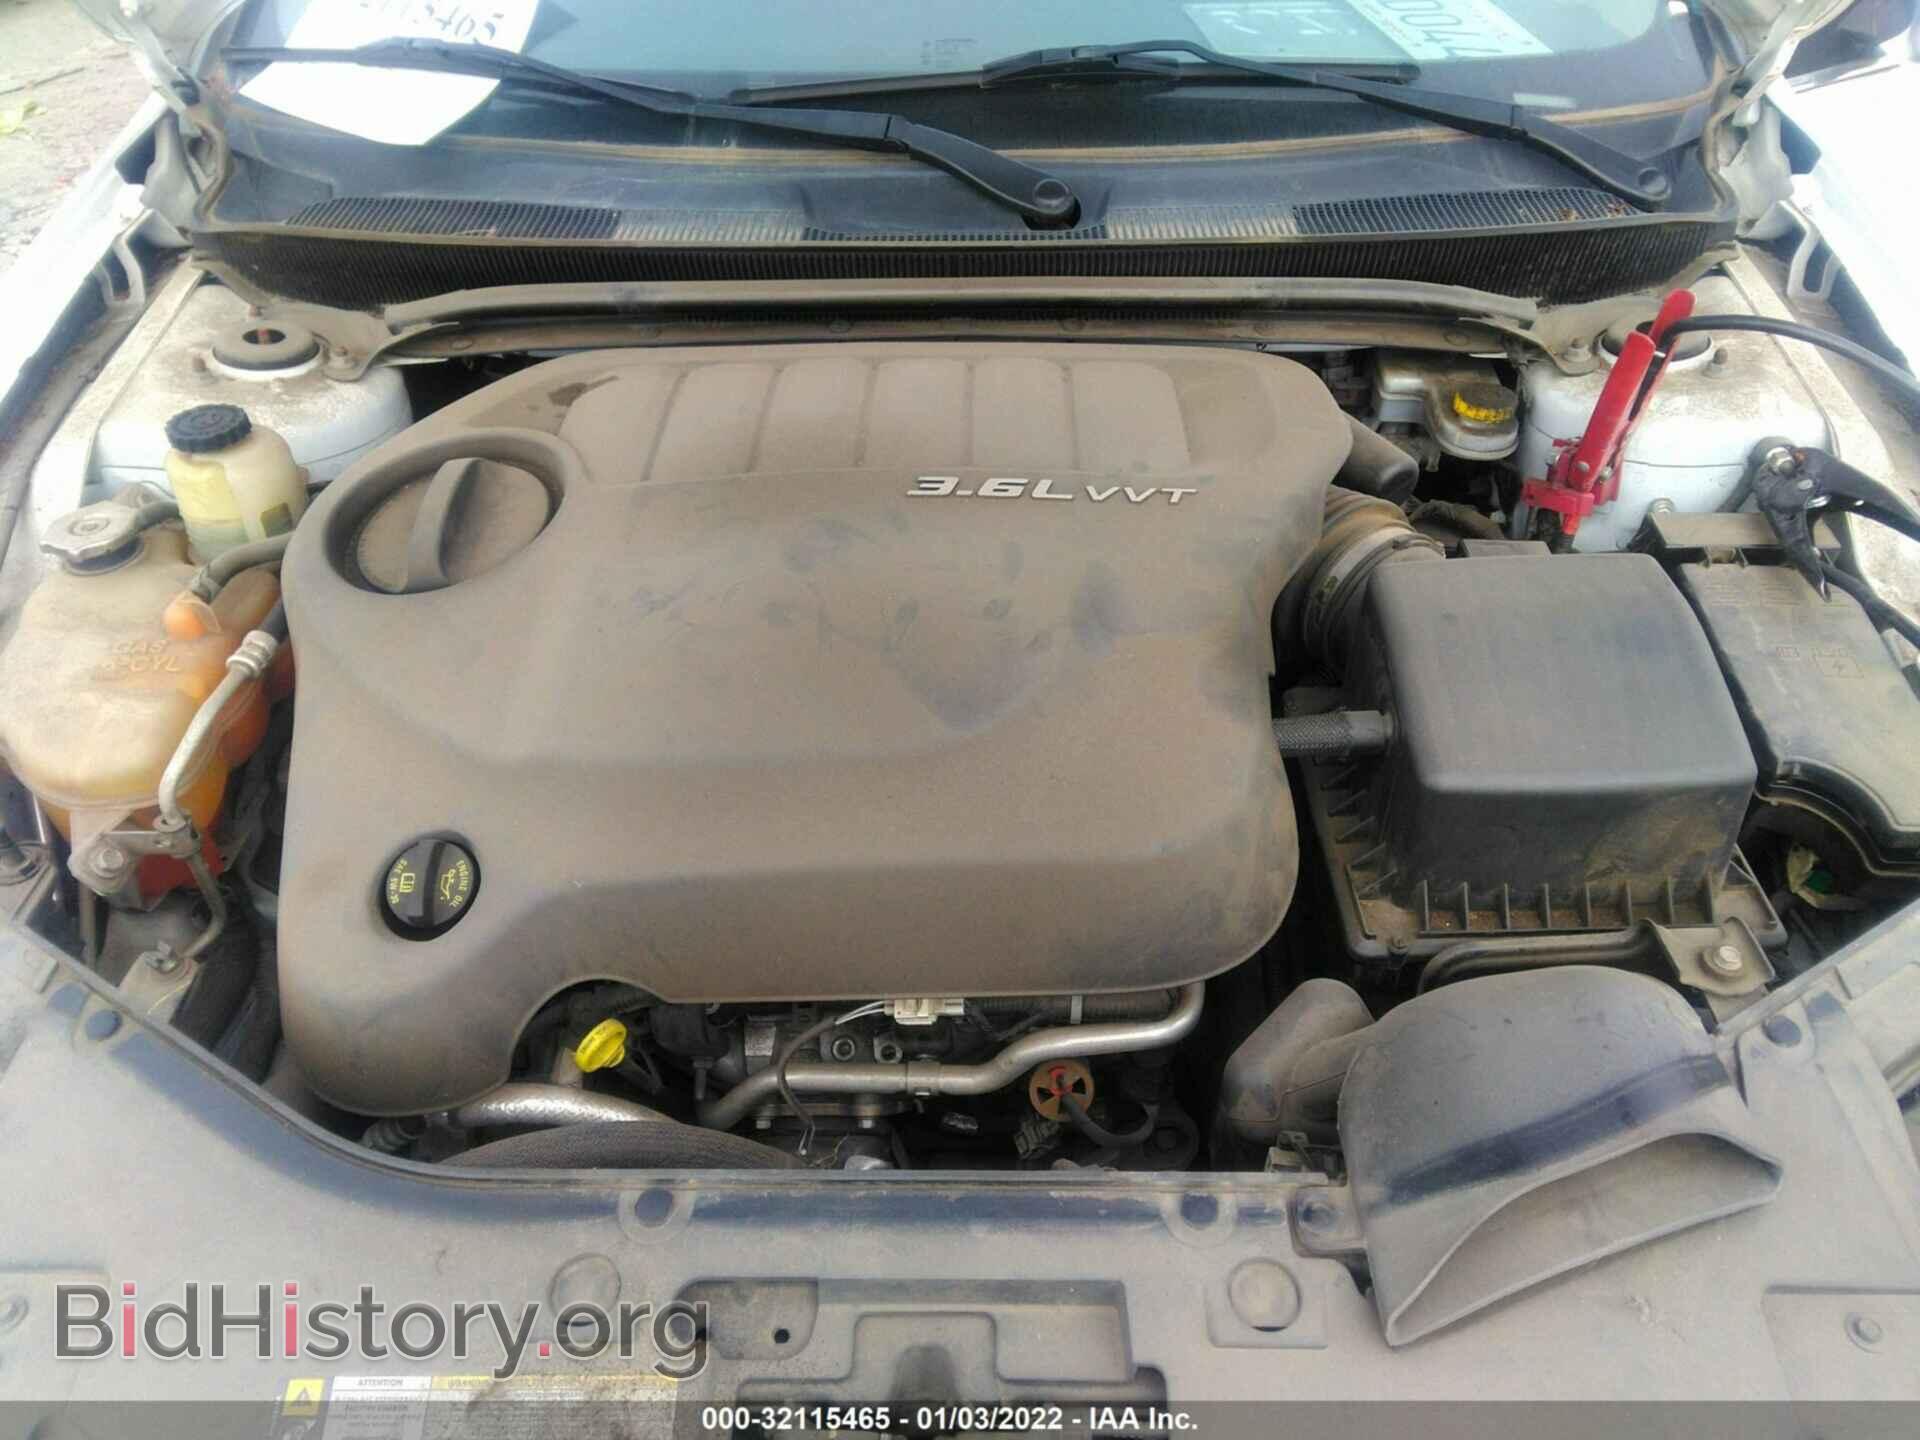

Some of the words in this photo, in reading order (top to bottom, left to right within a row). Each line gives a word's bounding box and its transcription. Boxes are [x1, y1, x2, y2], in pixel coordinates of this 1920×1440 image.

[905, 476, 1075, 501] 3.6L
[1085, 485, 1199, 505] VVT
[394, 859, 408, 874] SAE
[456, 860, 469, 891] ENGINE
[449, 894, 464, 908] OIL
